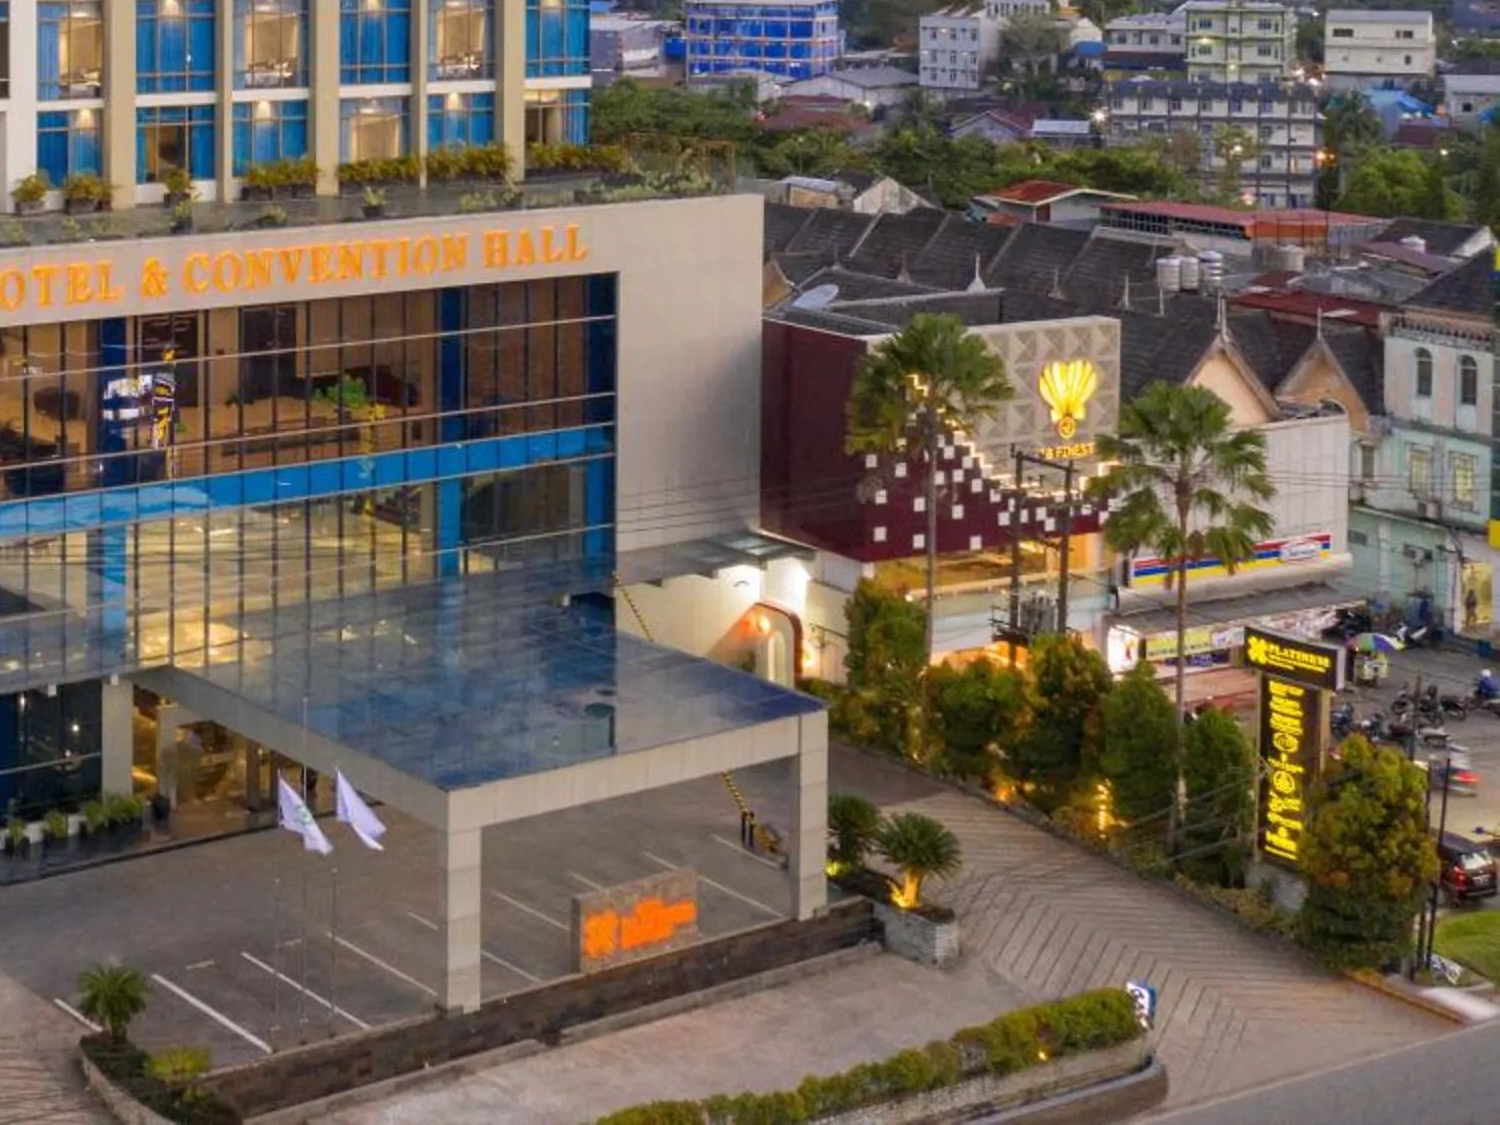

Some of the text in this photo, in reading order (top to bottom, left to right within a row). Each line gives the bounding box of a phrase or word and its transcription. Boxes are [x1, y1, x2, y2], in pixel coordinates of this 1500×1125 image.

[139, 255, 168, 298] &
[182, 232, 470, 293] CONVENTION
[482, 223, 590, 268] HALL
